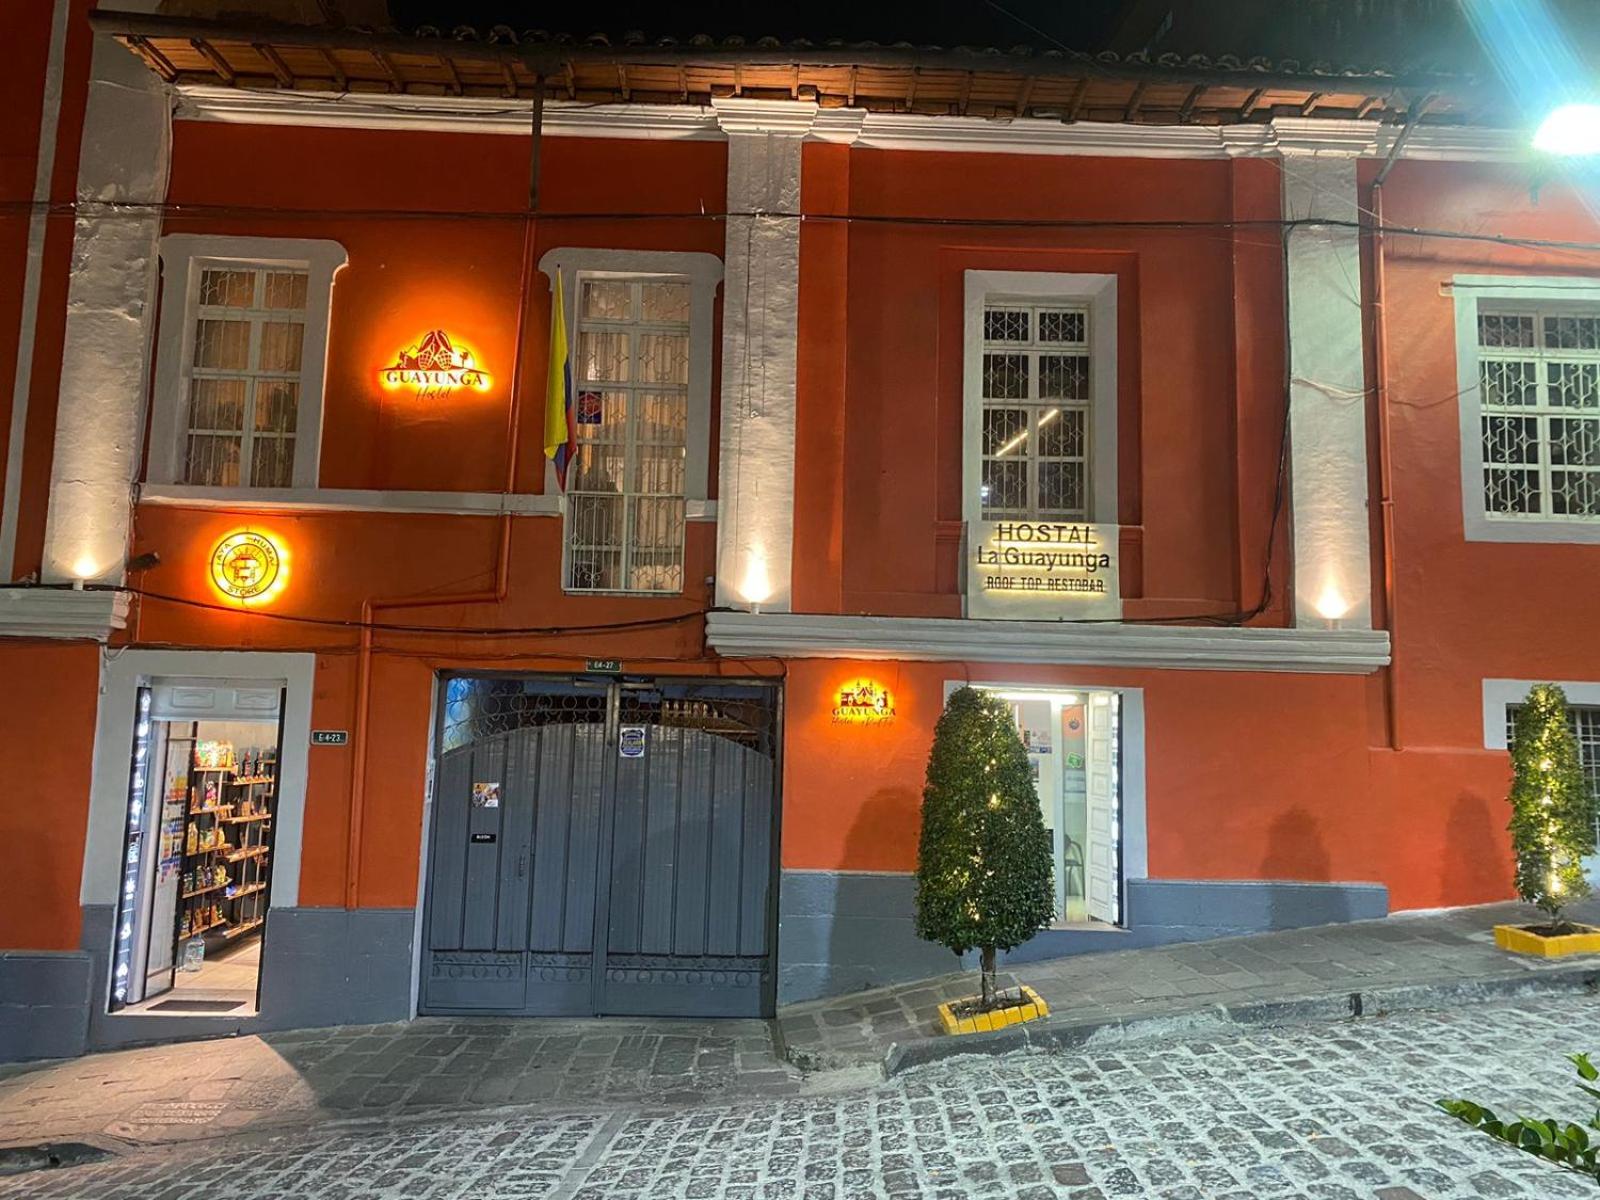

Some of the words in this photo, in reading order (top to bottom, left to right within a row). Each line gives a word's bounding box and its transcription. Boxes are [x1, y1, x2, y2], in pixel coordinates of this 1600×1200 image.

[386, 371, 483, 385] GUAYUNGA
[998, 523, 1095, 544] HOSTAL
[978, 546, 999, 564] La
[1004, 547, 1110, 573] Guayunga
[986, 576, 1014, 590] ROOF
[1021, 577, 1042, 591] TOP
[1048, 578, 1104, 593] RESTOBAR
[832, 708, 896, 716] GUAYUNGA
